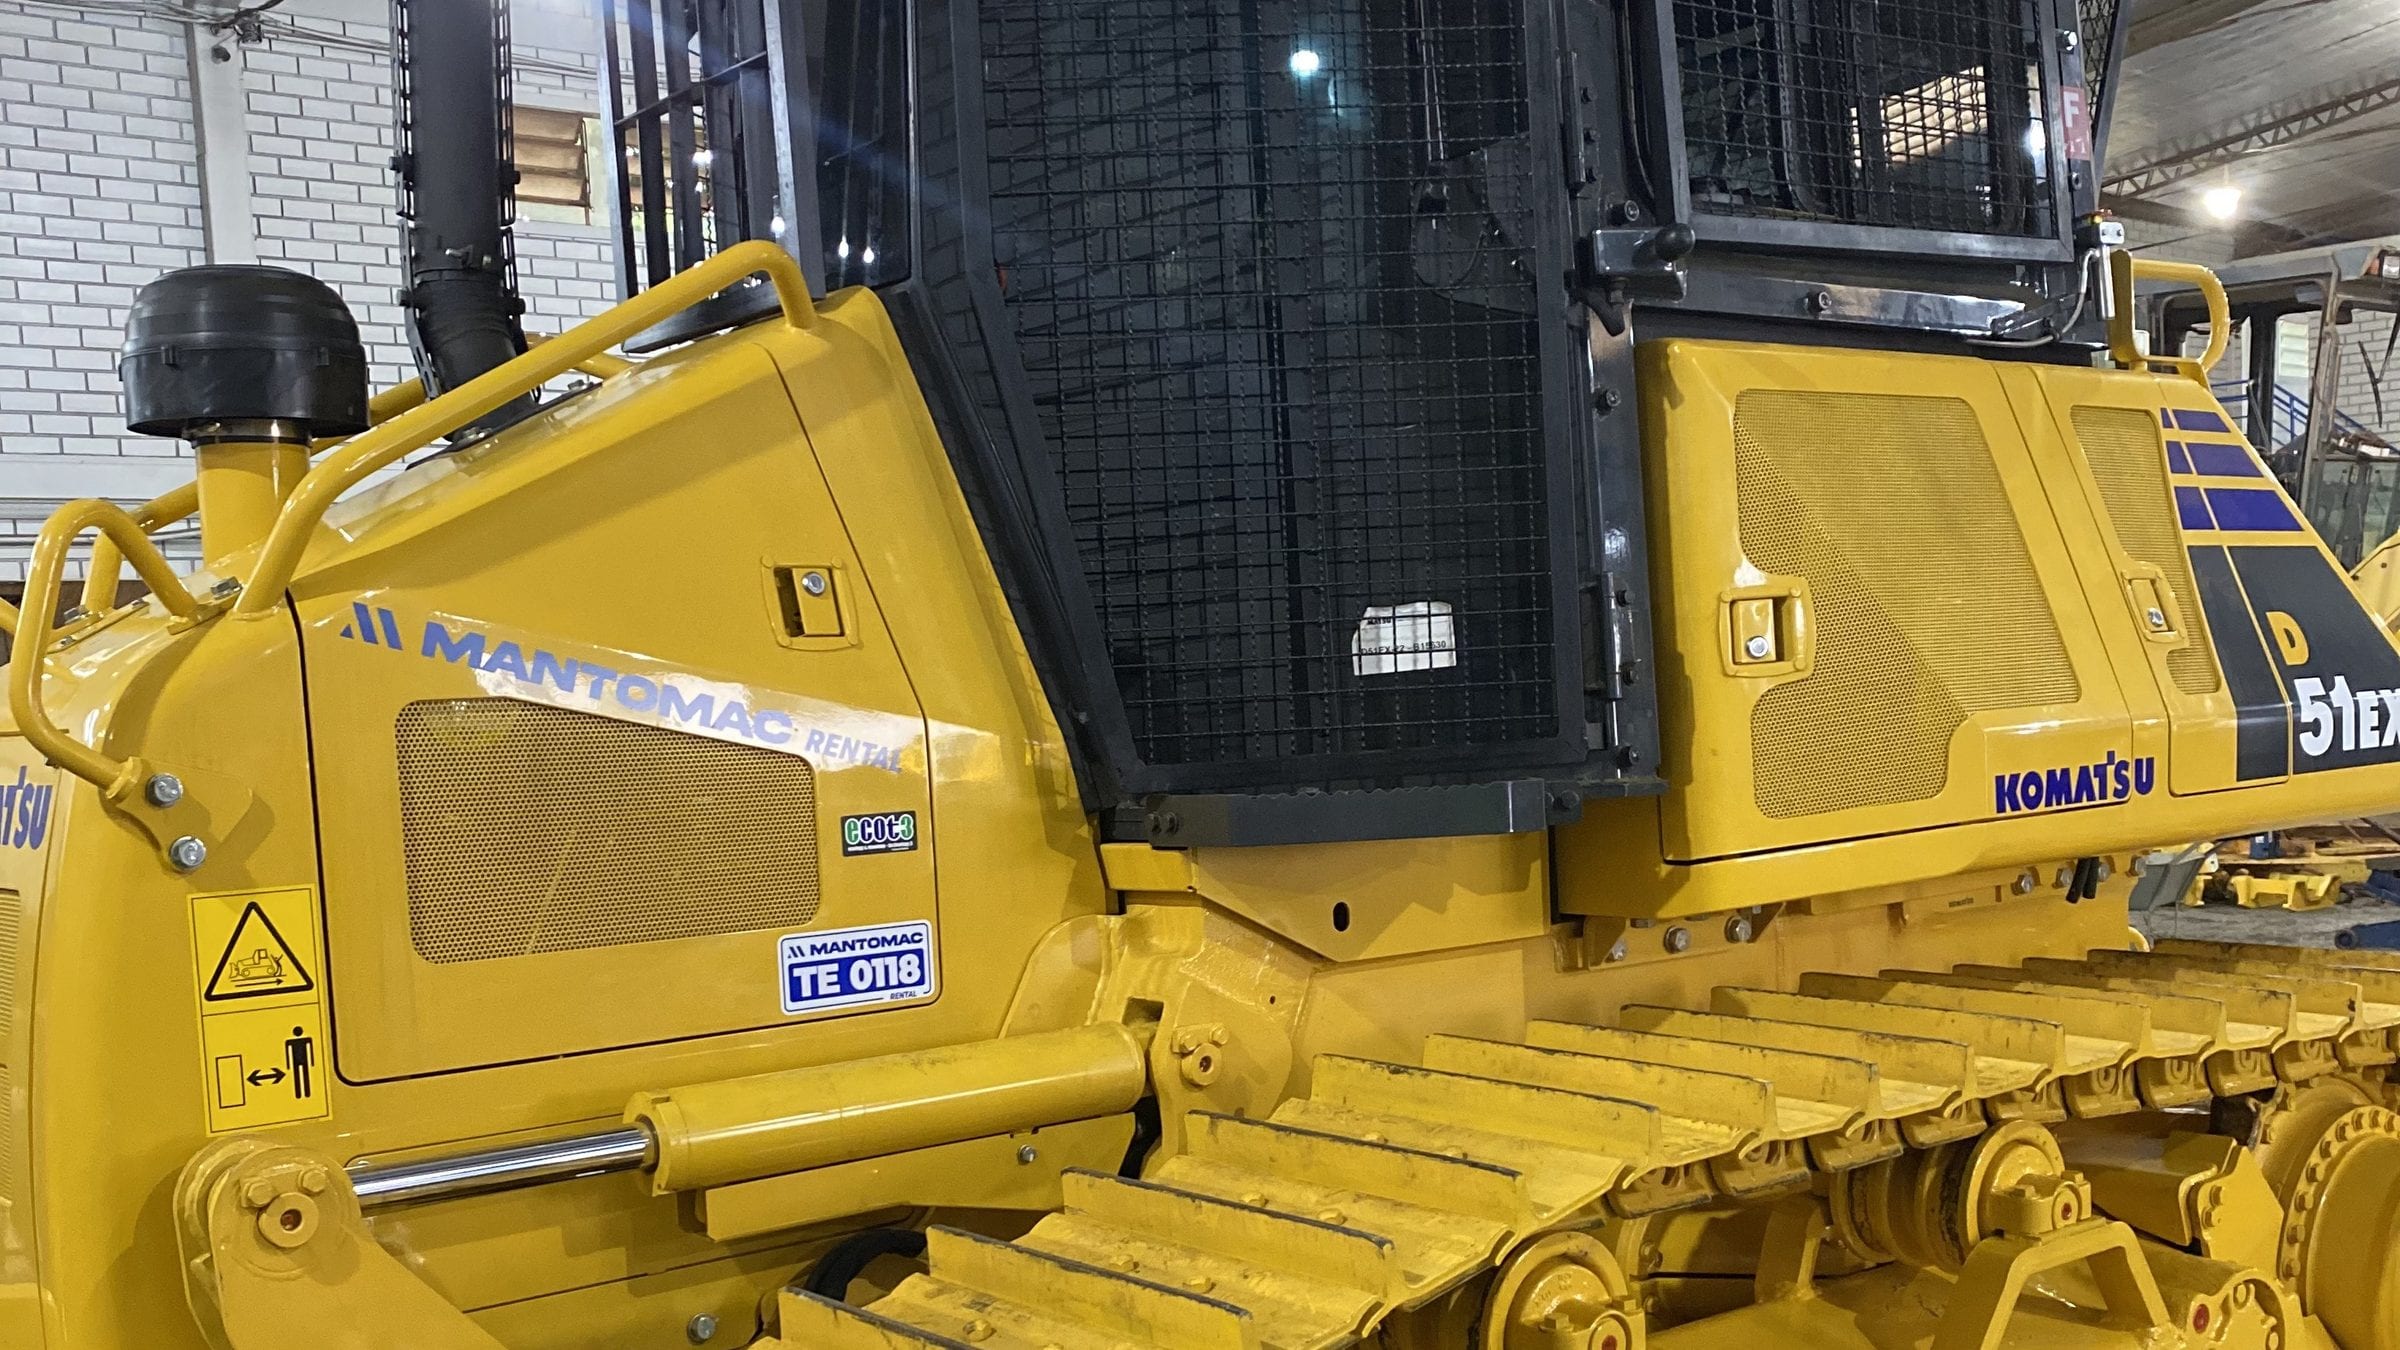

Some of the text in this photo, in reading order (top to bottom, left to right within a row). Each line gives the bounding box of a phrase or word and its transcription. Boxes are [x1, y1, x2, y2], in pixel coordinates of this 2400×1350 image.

[2265, 611, 2309, 666] D
[421, 620, 902, 773] MANTOMAC RENTAL
[2294, 675, 2400, 756] 51EX
[0, 765, 53, 850] TSU
[1995, 750, 2155, 814] KOMATSU
[844, 814, 914, 845] ecot3
[810, 932, 923, 956] MANTOMAC
[792, 953, 922, 997] TE 0118
[889, 991, 917, 1000] RENTAL
